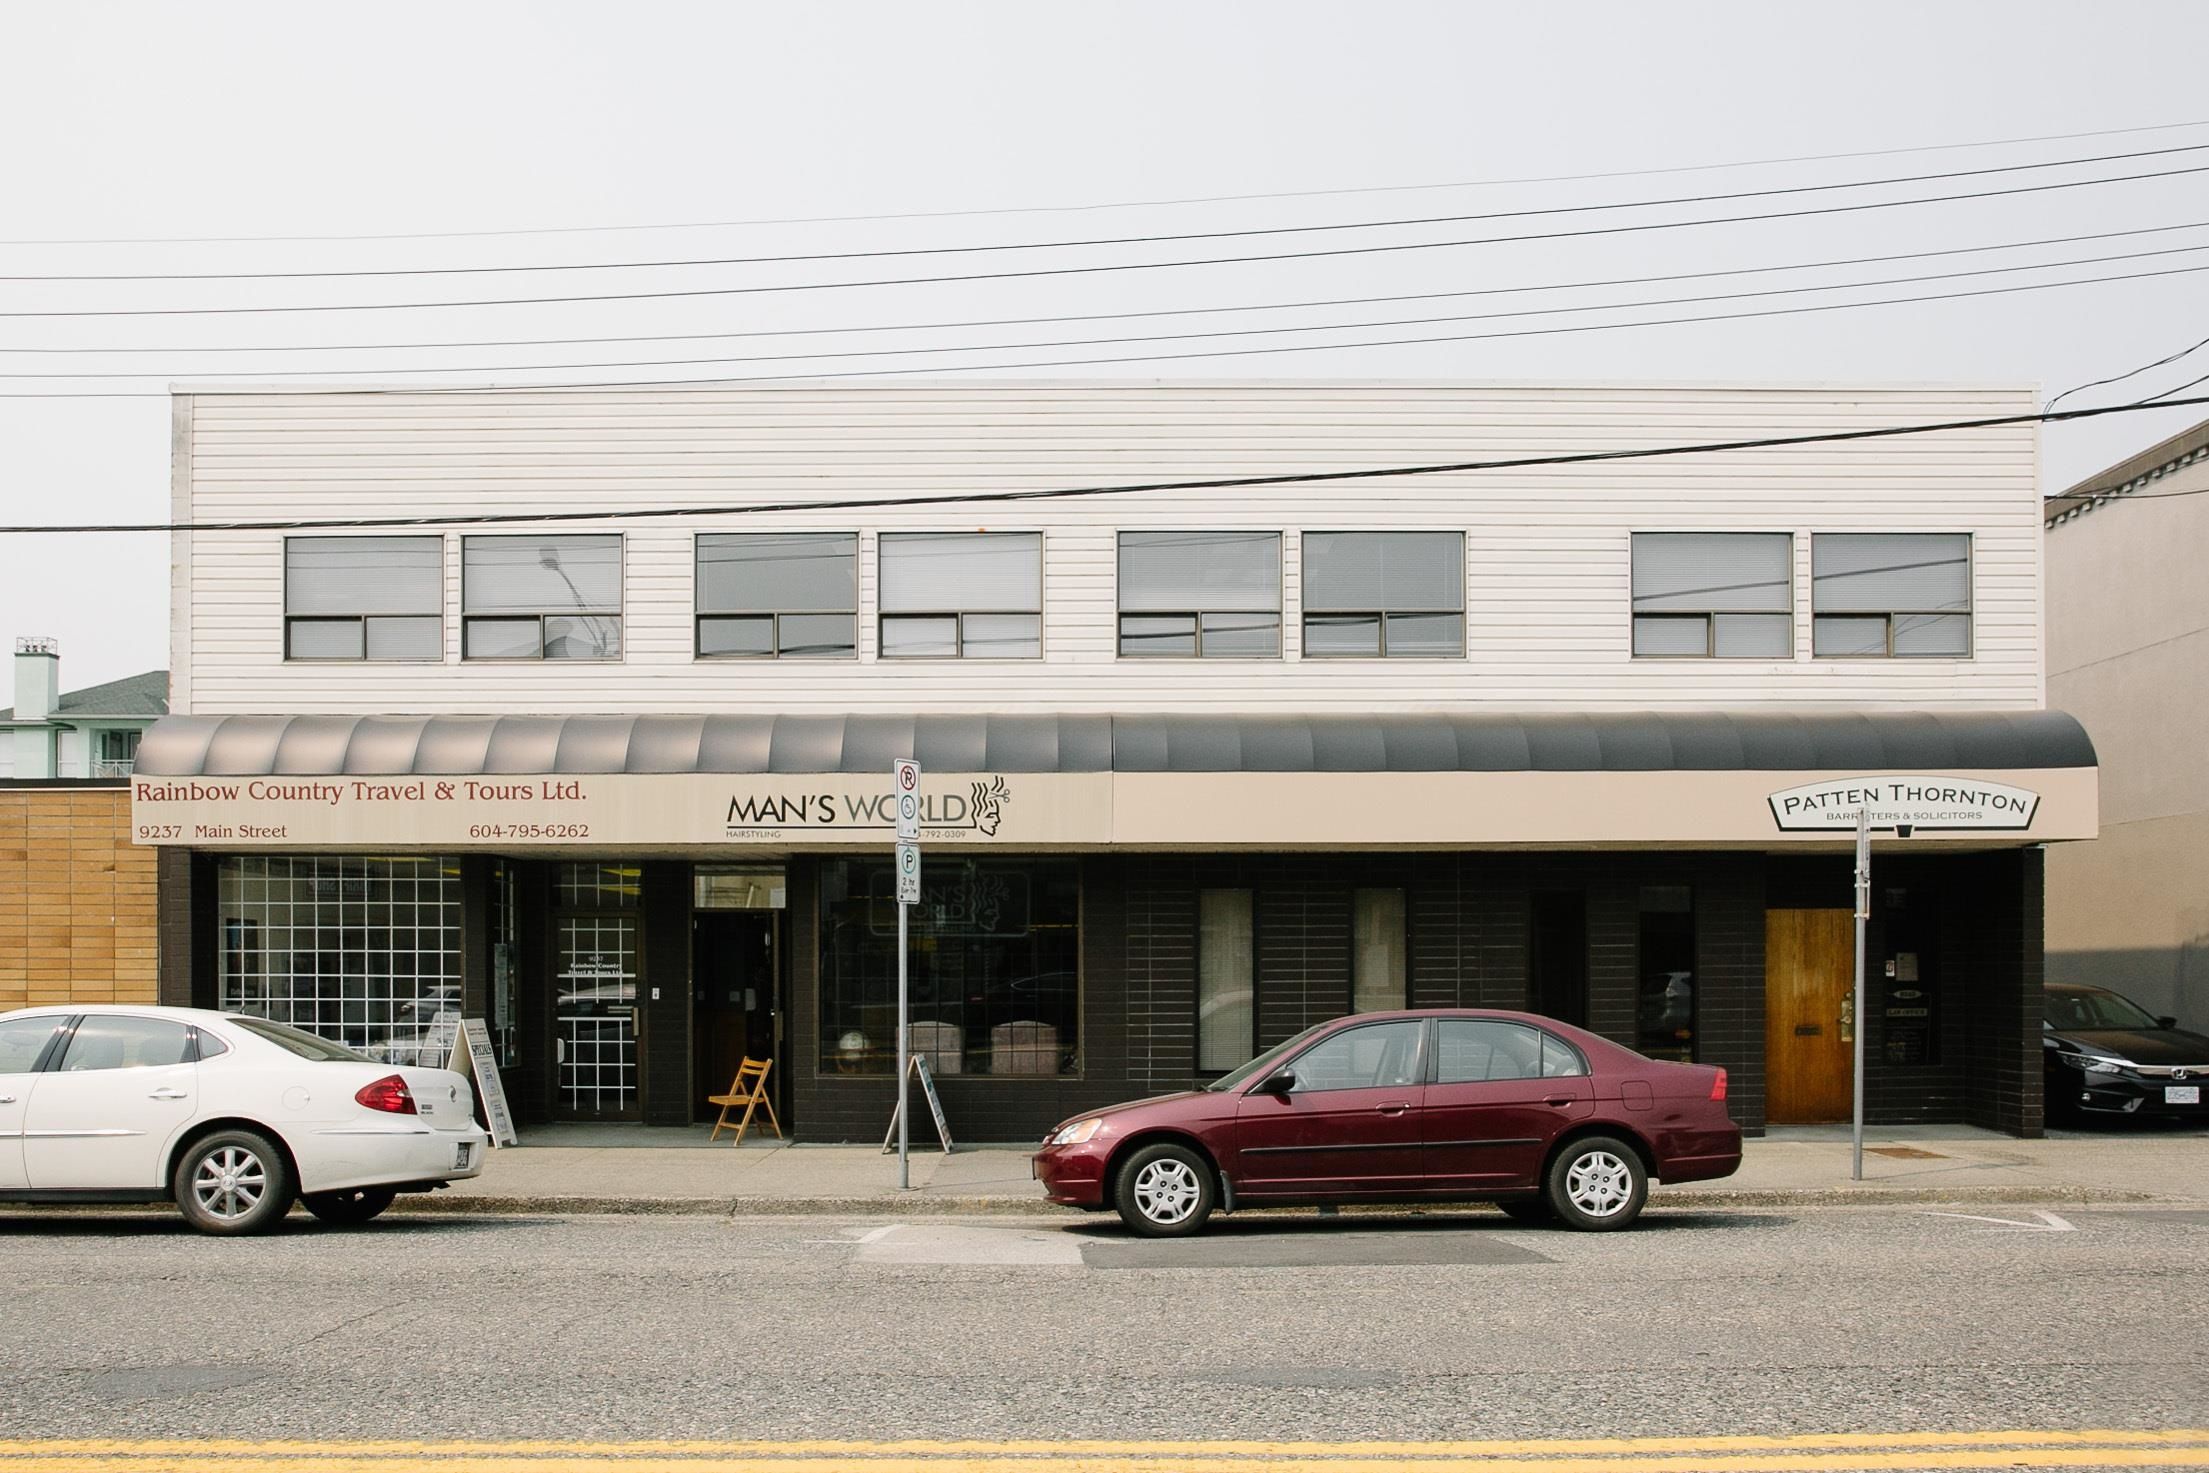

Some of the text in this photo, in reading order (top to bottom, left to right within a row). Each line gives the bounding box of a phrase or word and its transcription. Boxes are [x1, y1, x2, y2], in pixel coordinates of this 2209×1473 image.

[137, 780, 587, 806] Rainbow Country Travel & Tours Ltd.
[1783, 784, 2027, 815] PATTEN THORNTON
[727, 795, 836, 823] MAN'S
[1826, 811, 1983, 820] BARRTERS & SOLICITORS
[139, 824, 288, 839] 9237 Main Street
[469, 824, 589, 838] 604-795-6262
[726, 830, 781, 838] HAIRSTYLING
[919, 830, 966, 838] -792-0309
